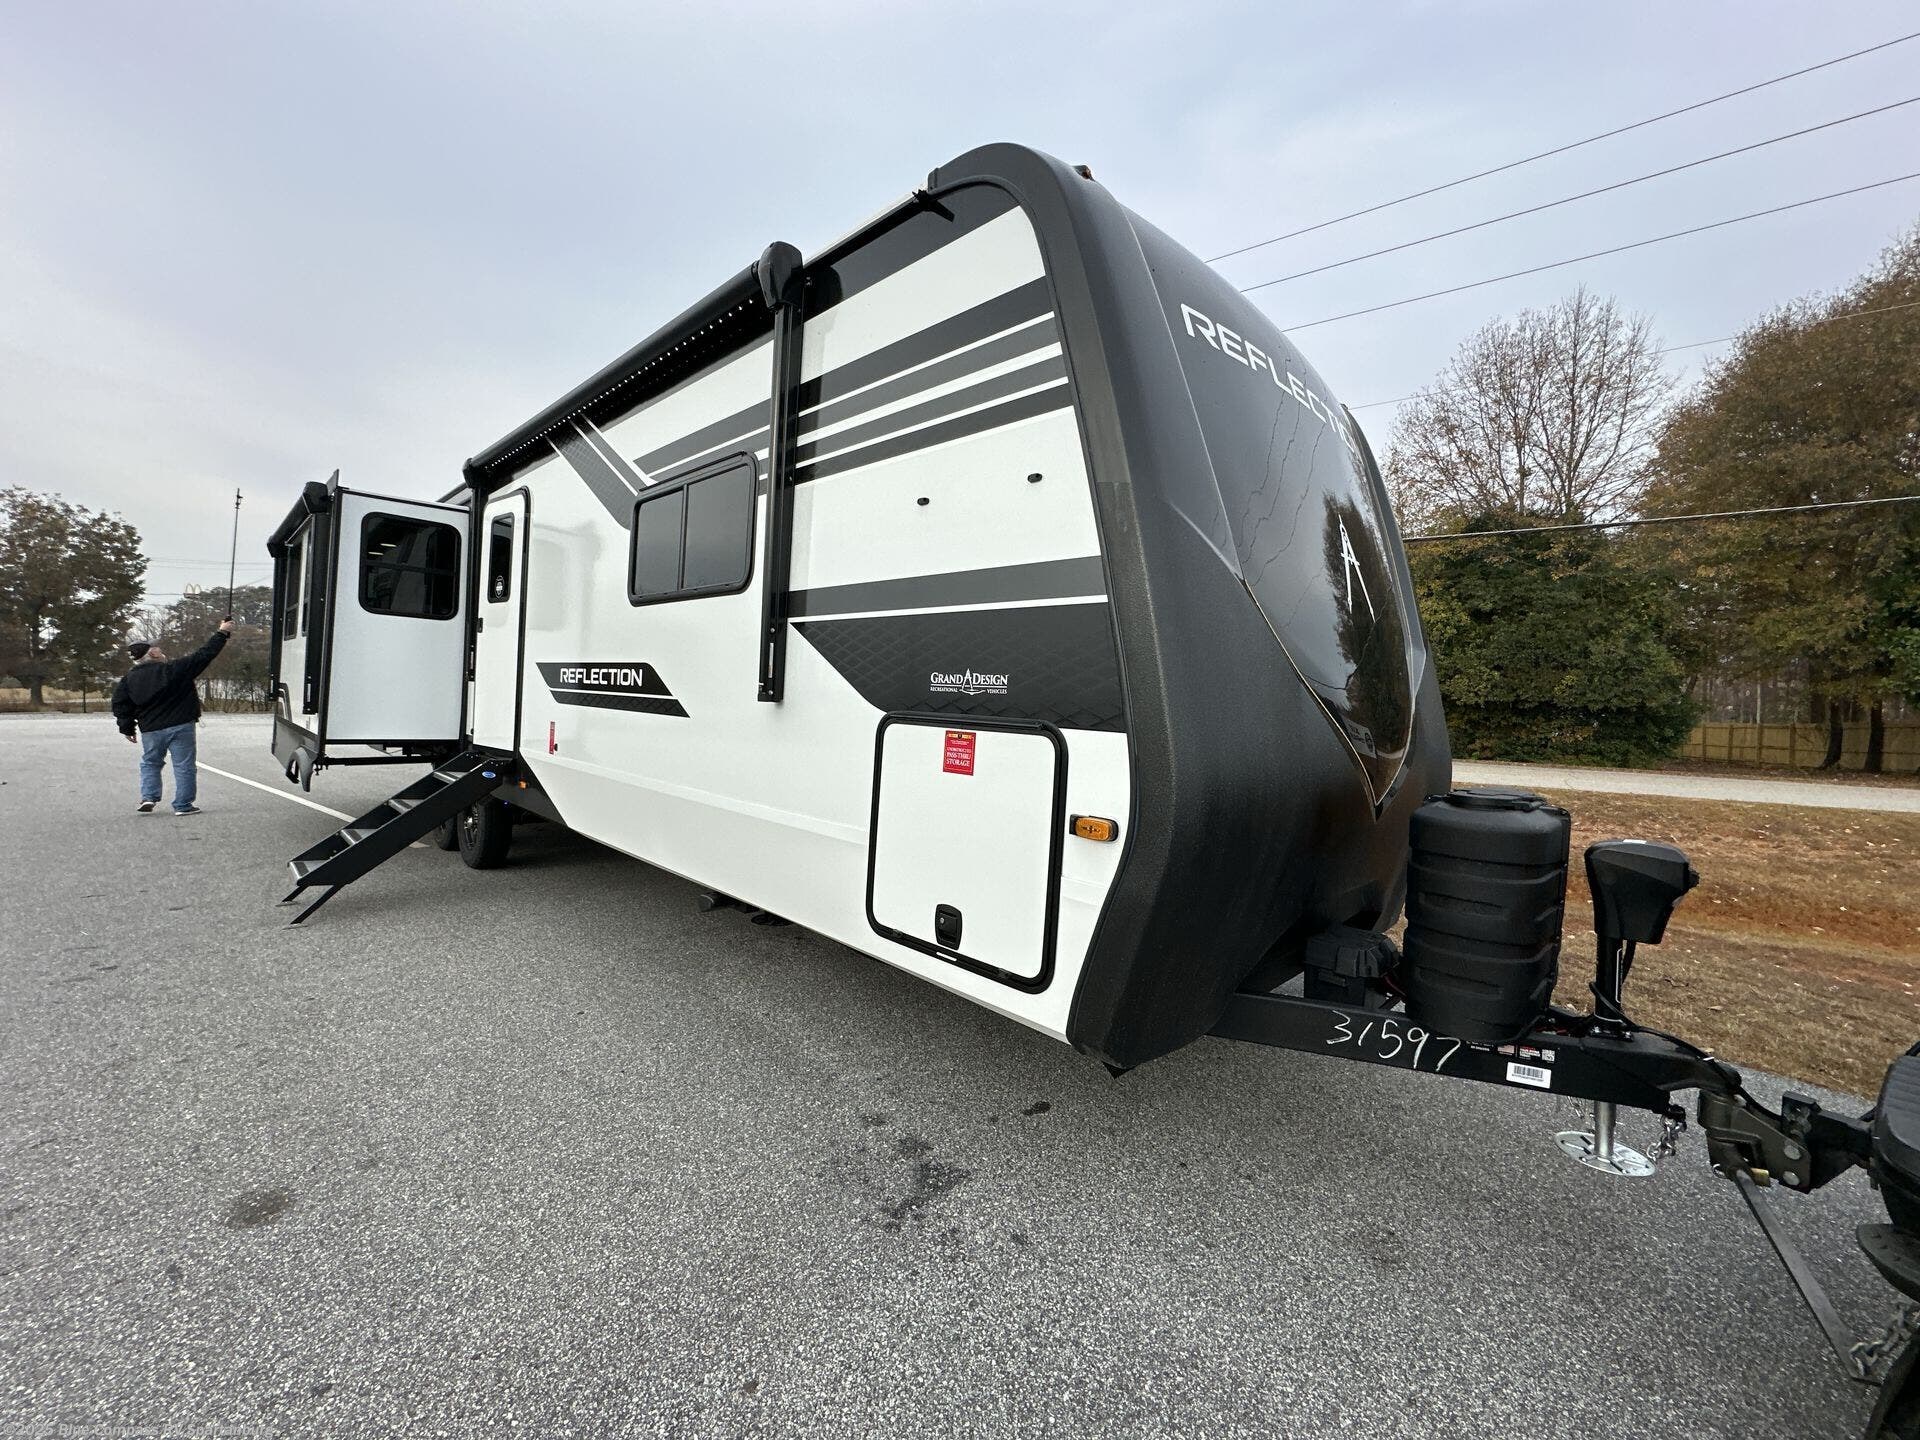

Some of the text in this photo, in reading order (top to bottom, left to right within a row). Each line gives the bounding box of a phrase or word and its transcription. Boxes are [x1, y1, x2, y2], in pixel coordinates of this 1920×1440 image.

[1181, 303, 1355, 453] REFLECTIO
[560, 668, 643, 687] REFLECTION
[930, 672, 1008, 685] GRAND DESIGN
[946, 758, 970, 767] STORAGE
[1326, 1009, 1461, 1072] 31597
